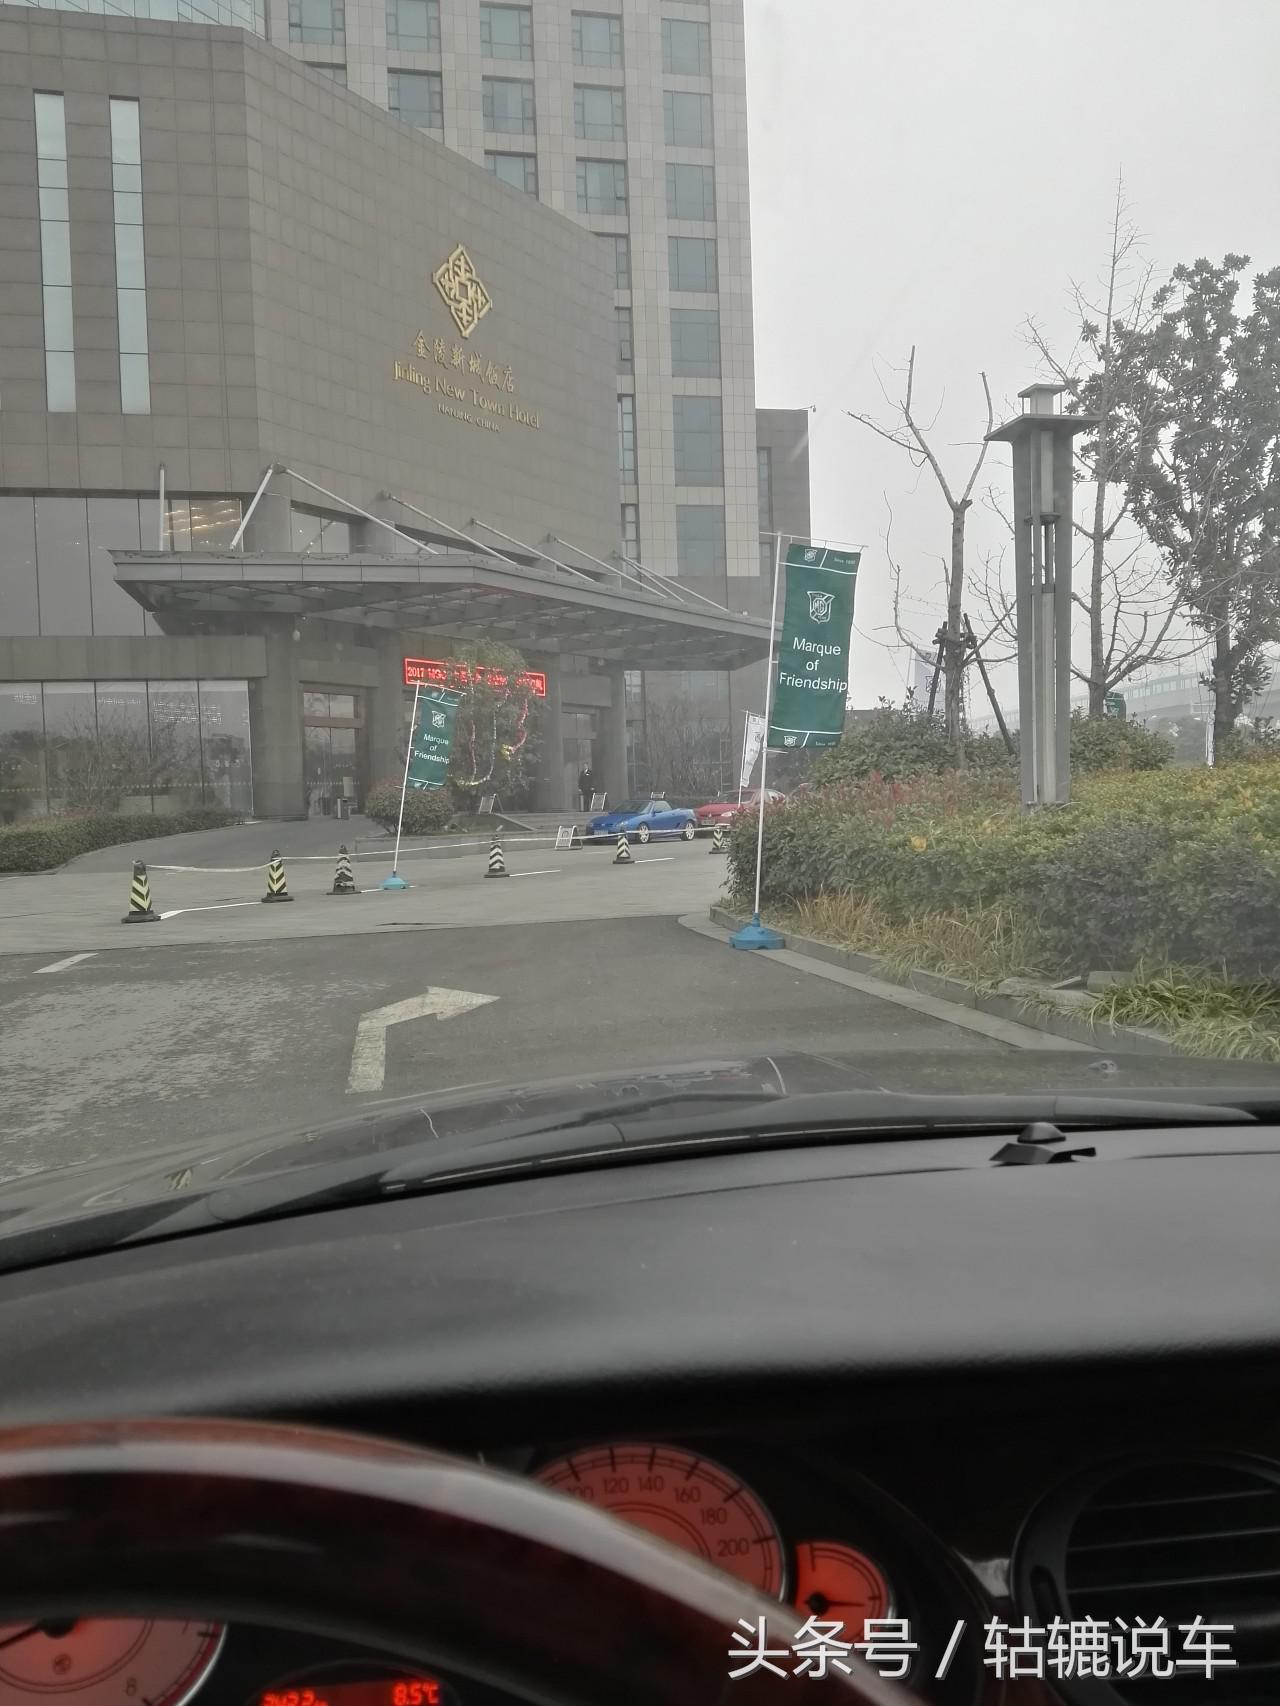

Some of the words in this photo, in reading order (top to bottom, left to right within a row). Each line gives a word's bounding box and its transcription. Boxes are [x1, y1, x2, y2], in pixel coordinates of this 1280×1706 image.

[393, 359, 432, 395] Jinling
[434, 375, 465, 401] New
[470, 388, 505, 416] Town
[508, 402, 540, 429] Hotel
[793, 637, 842, 656] Marque
[407, 666, 425, 679] 2017
[806, 659, 820, 671] of
[779, 672, 848, 693] Friendship
[423, 733, 449, 745] Marque
[414, 750, 450, 765] Friendship
[603, 1477, 630, 1494] 120
[638, 1475, 665, 1493] 140
[674, 1486, 701, 1504] 160
[700, 1508, 728, 1525] 180
[717, 1537, 750, 1557] 200
